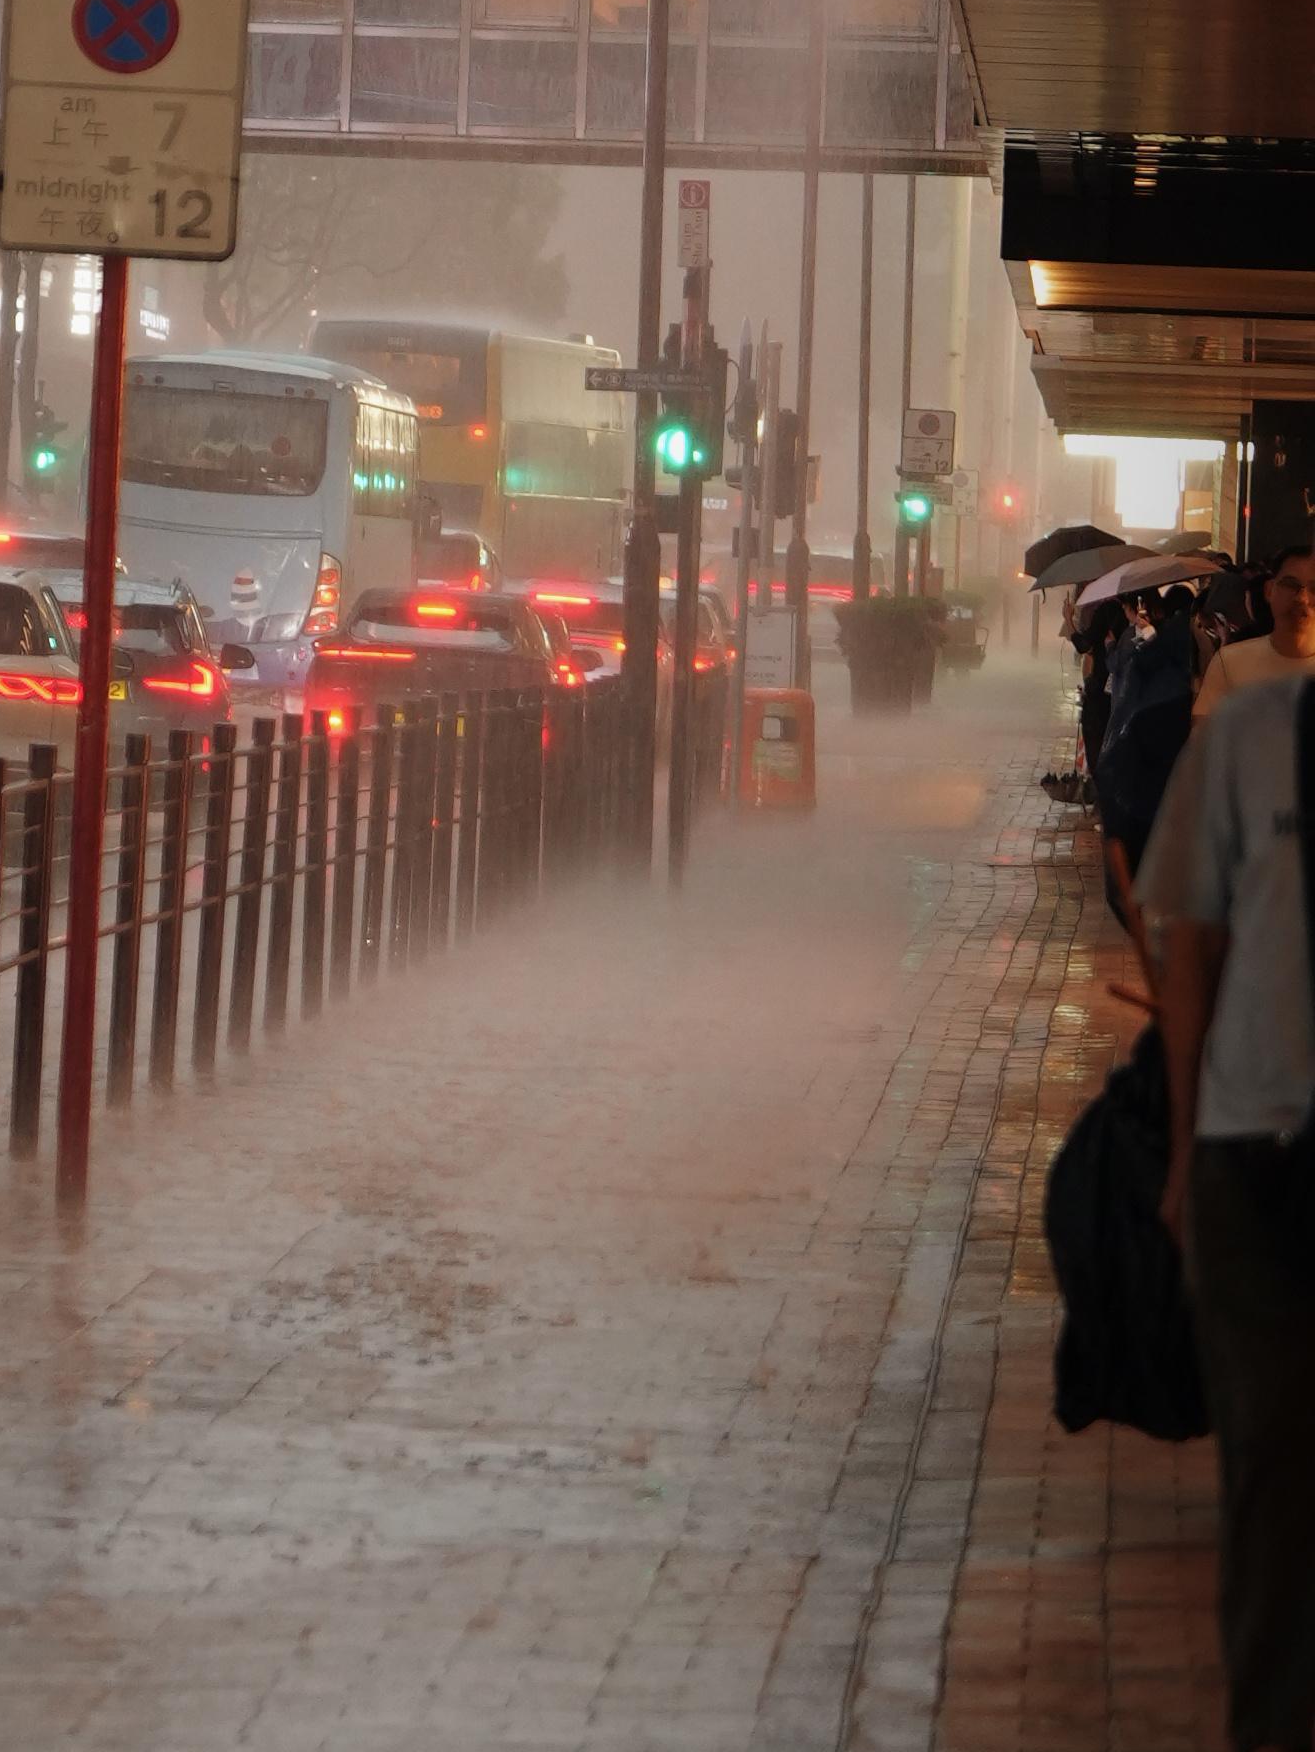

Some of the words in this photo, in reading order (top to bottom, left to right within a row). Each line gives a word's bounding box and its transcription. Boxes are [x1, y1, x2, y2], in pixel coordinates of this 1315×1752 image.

[42, 119, 110, 147] 上午
[60, 98, 97, 113] am
[153, 101, 187, 152] 7
[13, 176, 131, 203] midnight
[149, 188, 213, 239] 12
[37, 207, 107, 237] 午夜
